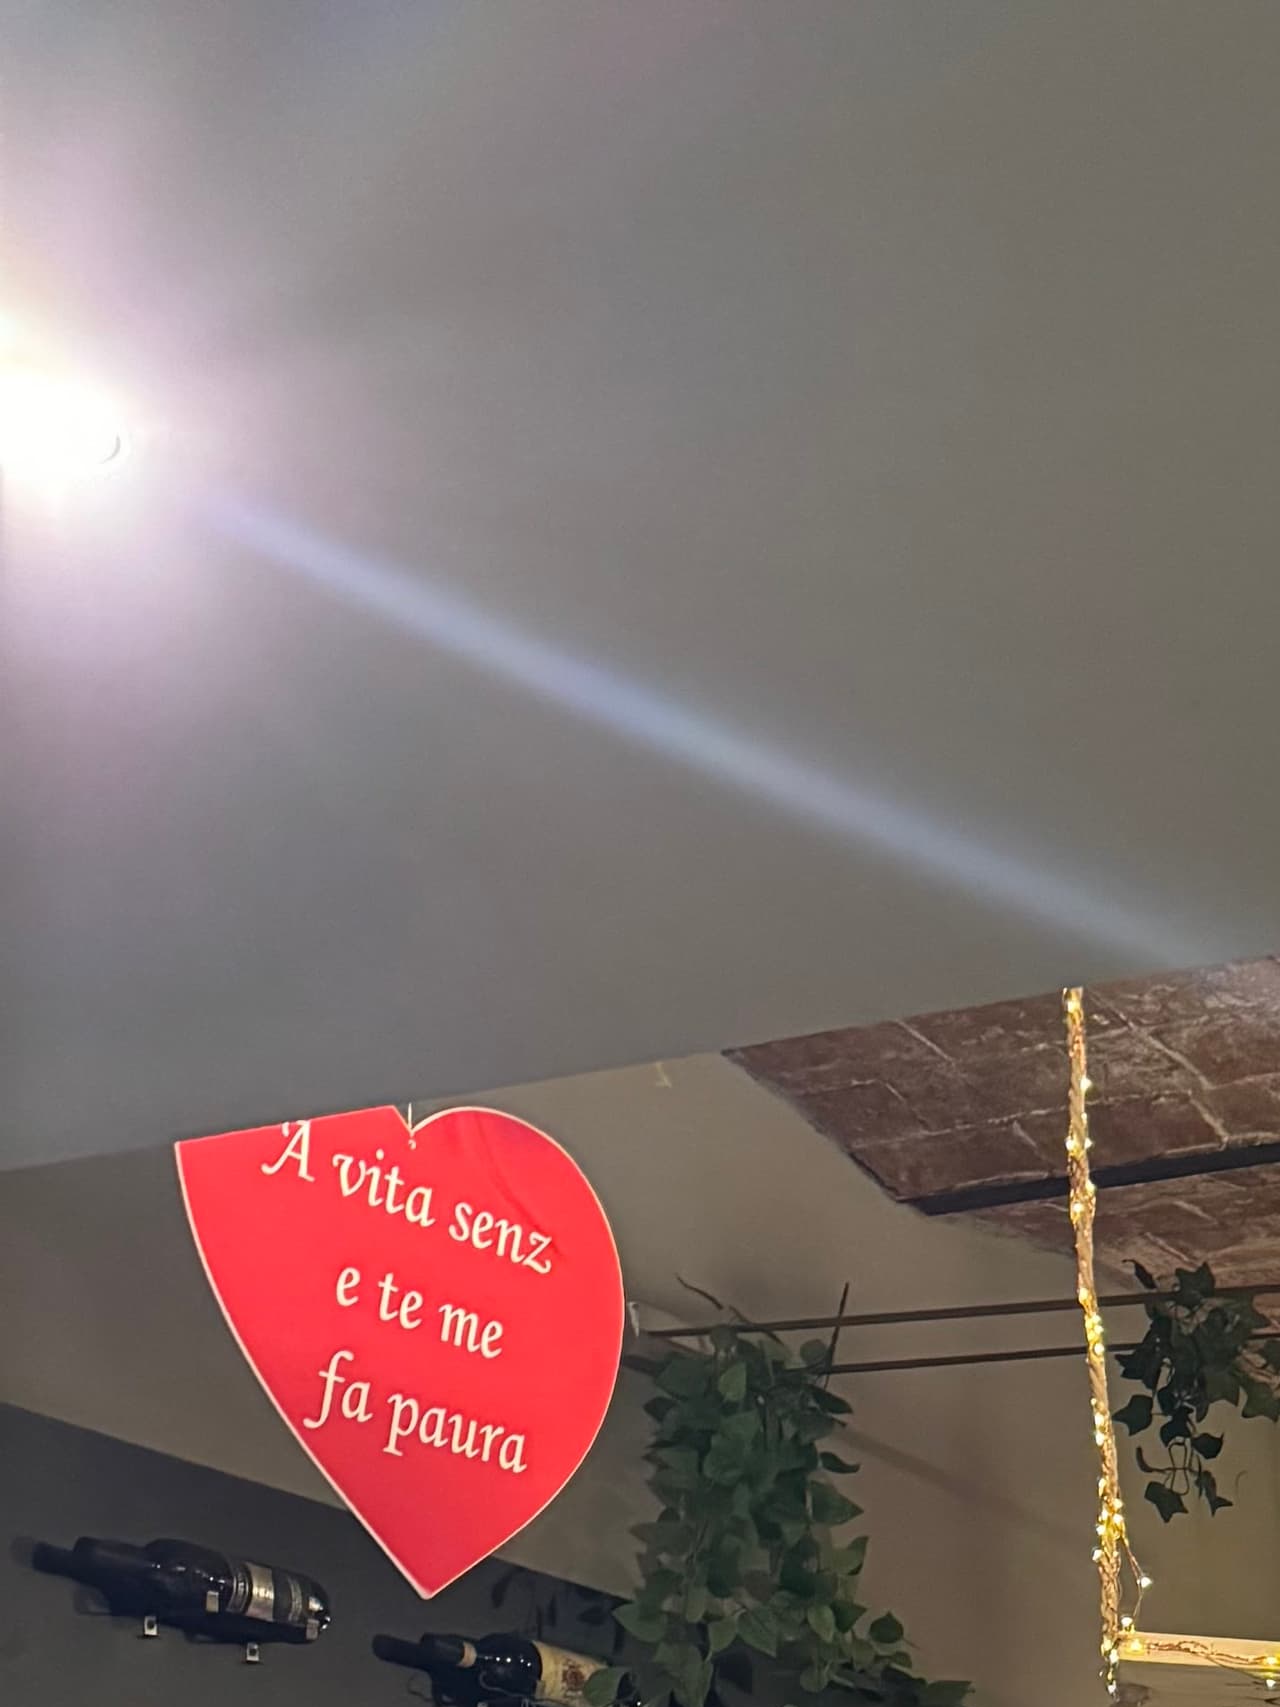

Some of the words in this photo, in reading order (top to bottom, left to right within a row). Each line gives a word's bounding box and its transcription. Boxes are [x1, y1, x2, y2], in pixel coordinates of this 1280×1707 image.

[333, 1149, 434, 1228] vita
[448, 1203, 552, 1274] senz
[335, 1266, 359, 1307] e
[378, 1272, 423, 1330] te
[438, 1302, 504, 1358] me
[303, 1351, 372, 1430] fa
[383, 1393, 528, 1473] paura
